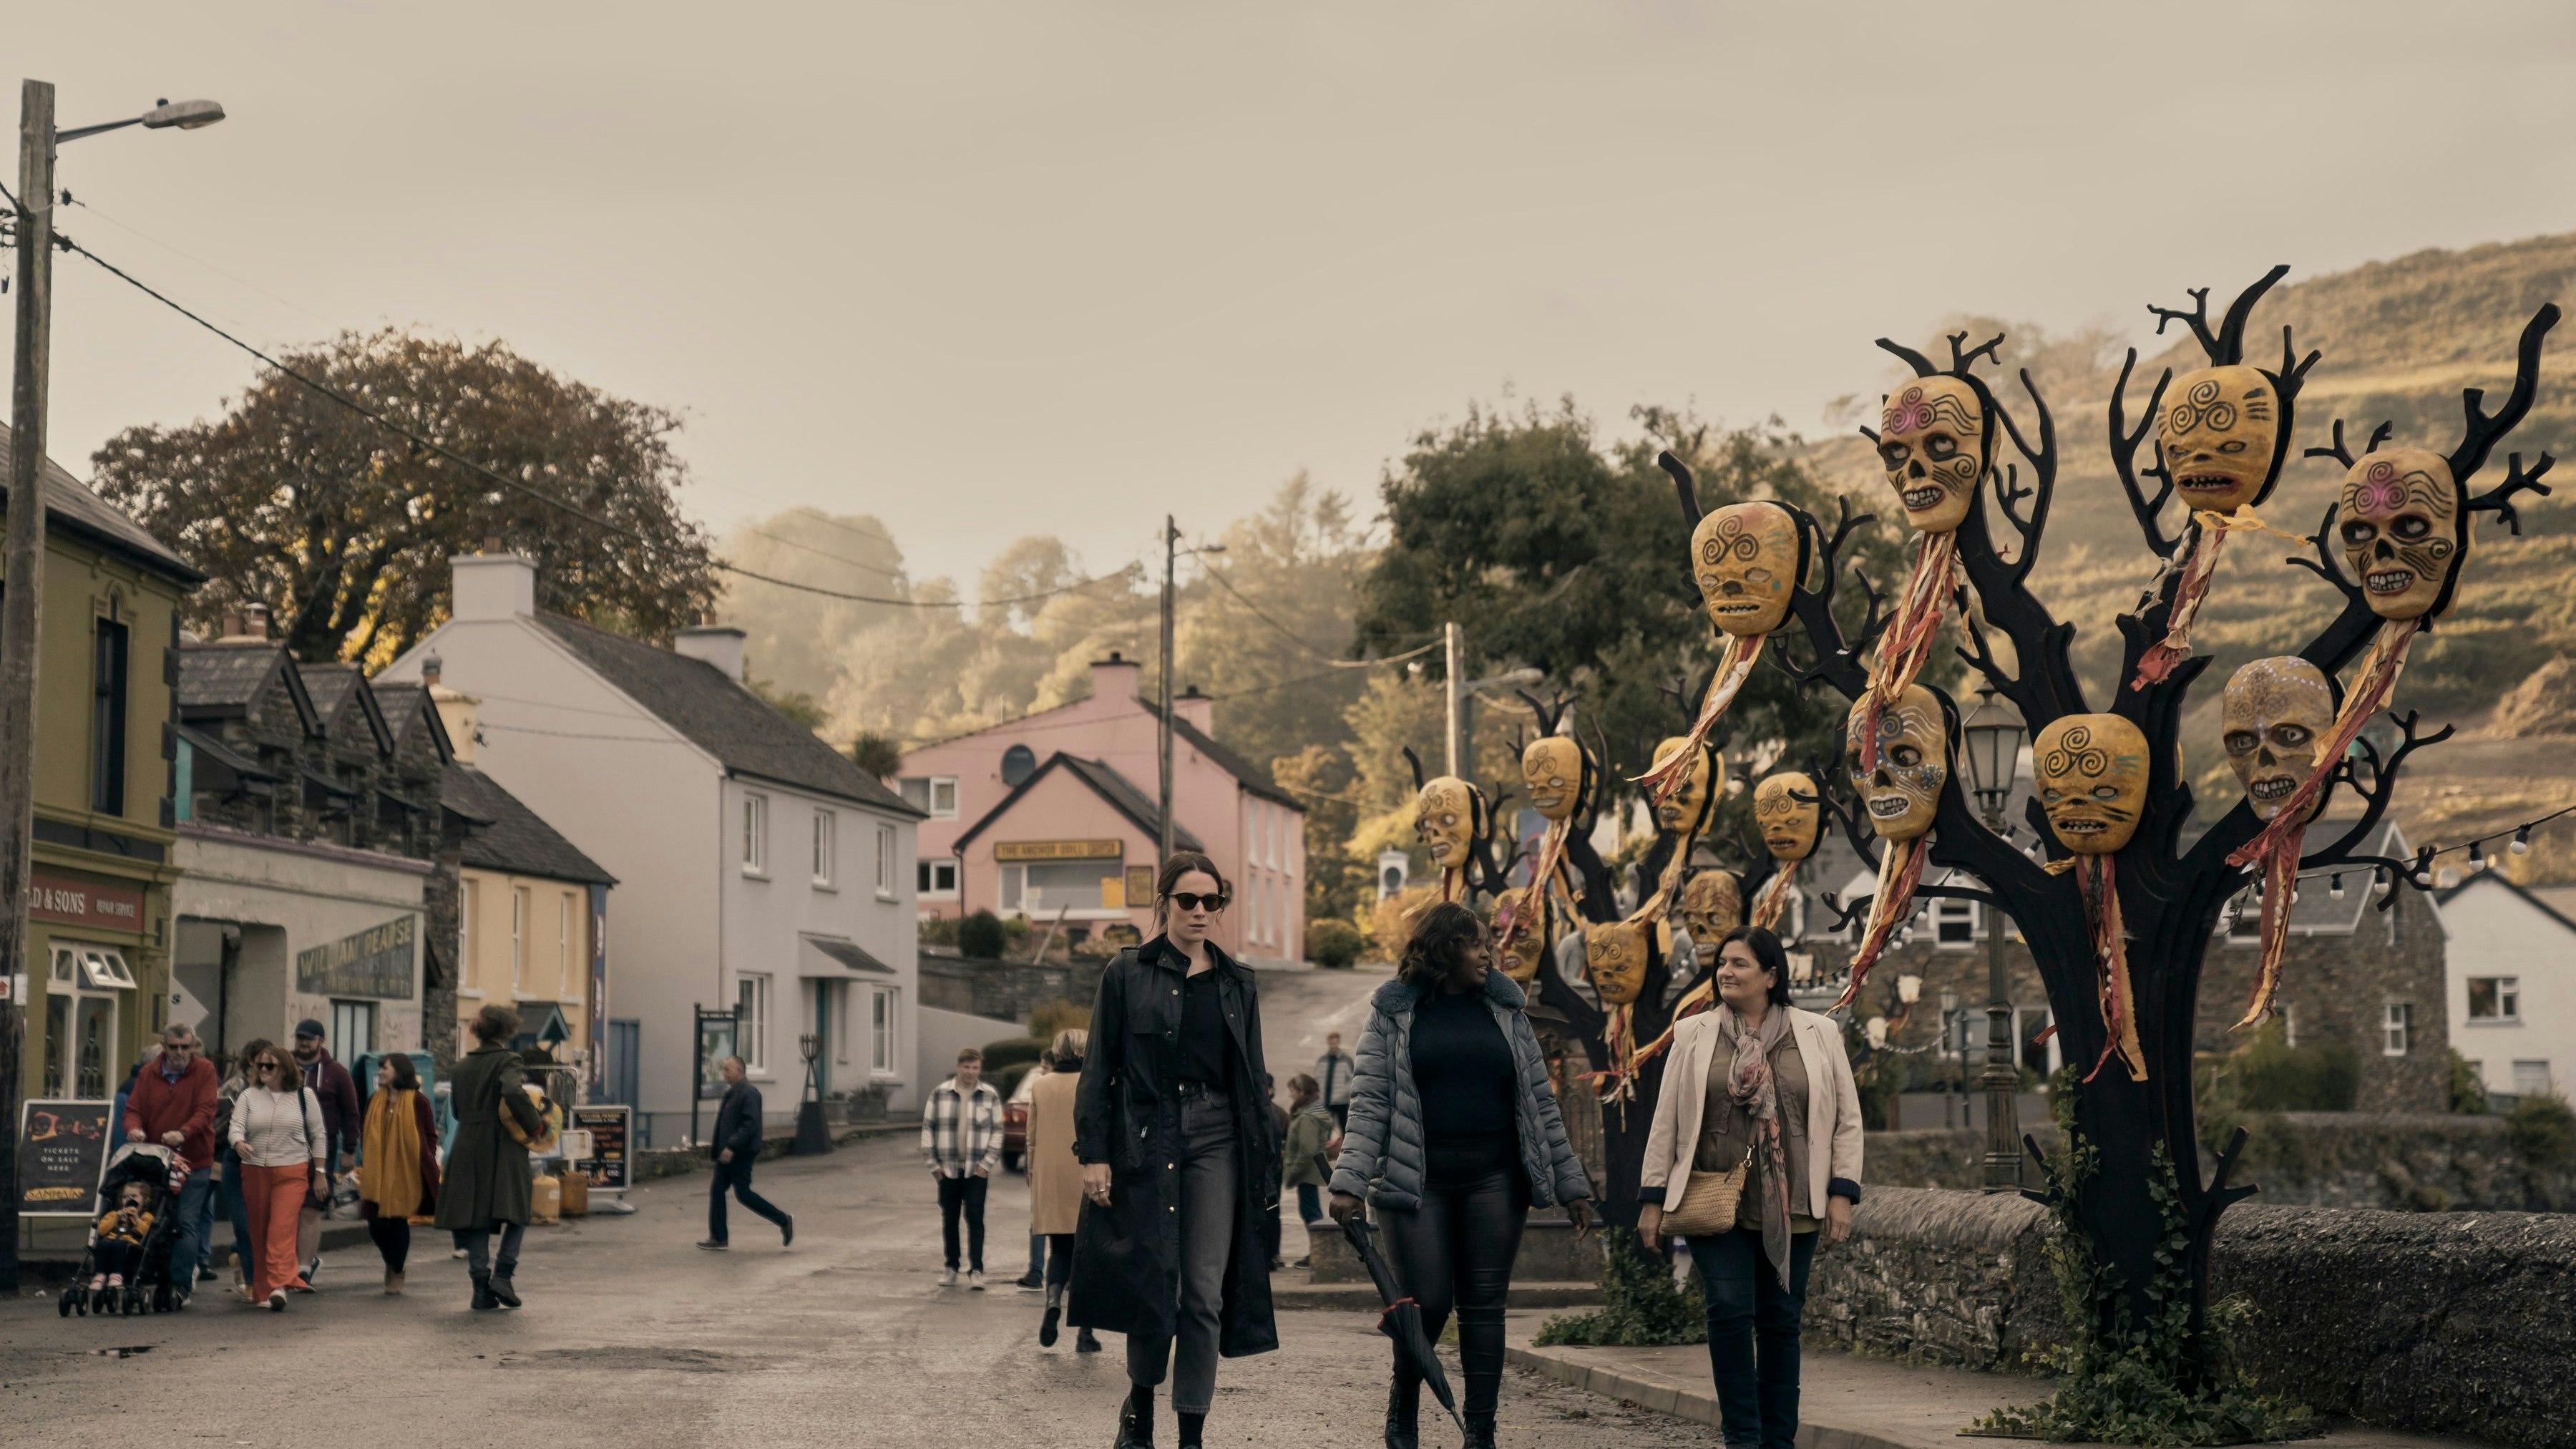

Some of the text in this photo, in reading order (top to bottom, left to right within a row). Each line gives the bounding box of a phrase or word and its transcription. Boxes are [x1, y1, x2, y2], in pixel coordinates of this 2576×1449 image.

[44, 888, 53, 911] &
[54, 889, 84, 915] SONS
[96, 899, 135, 919] REPAIR SERVICE
